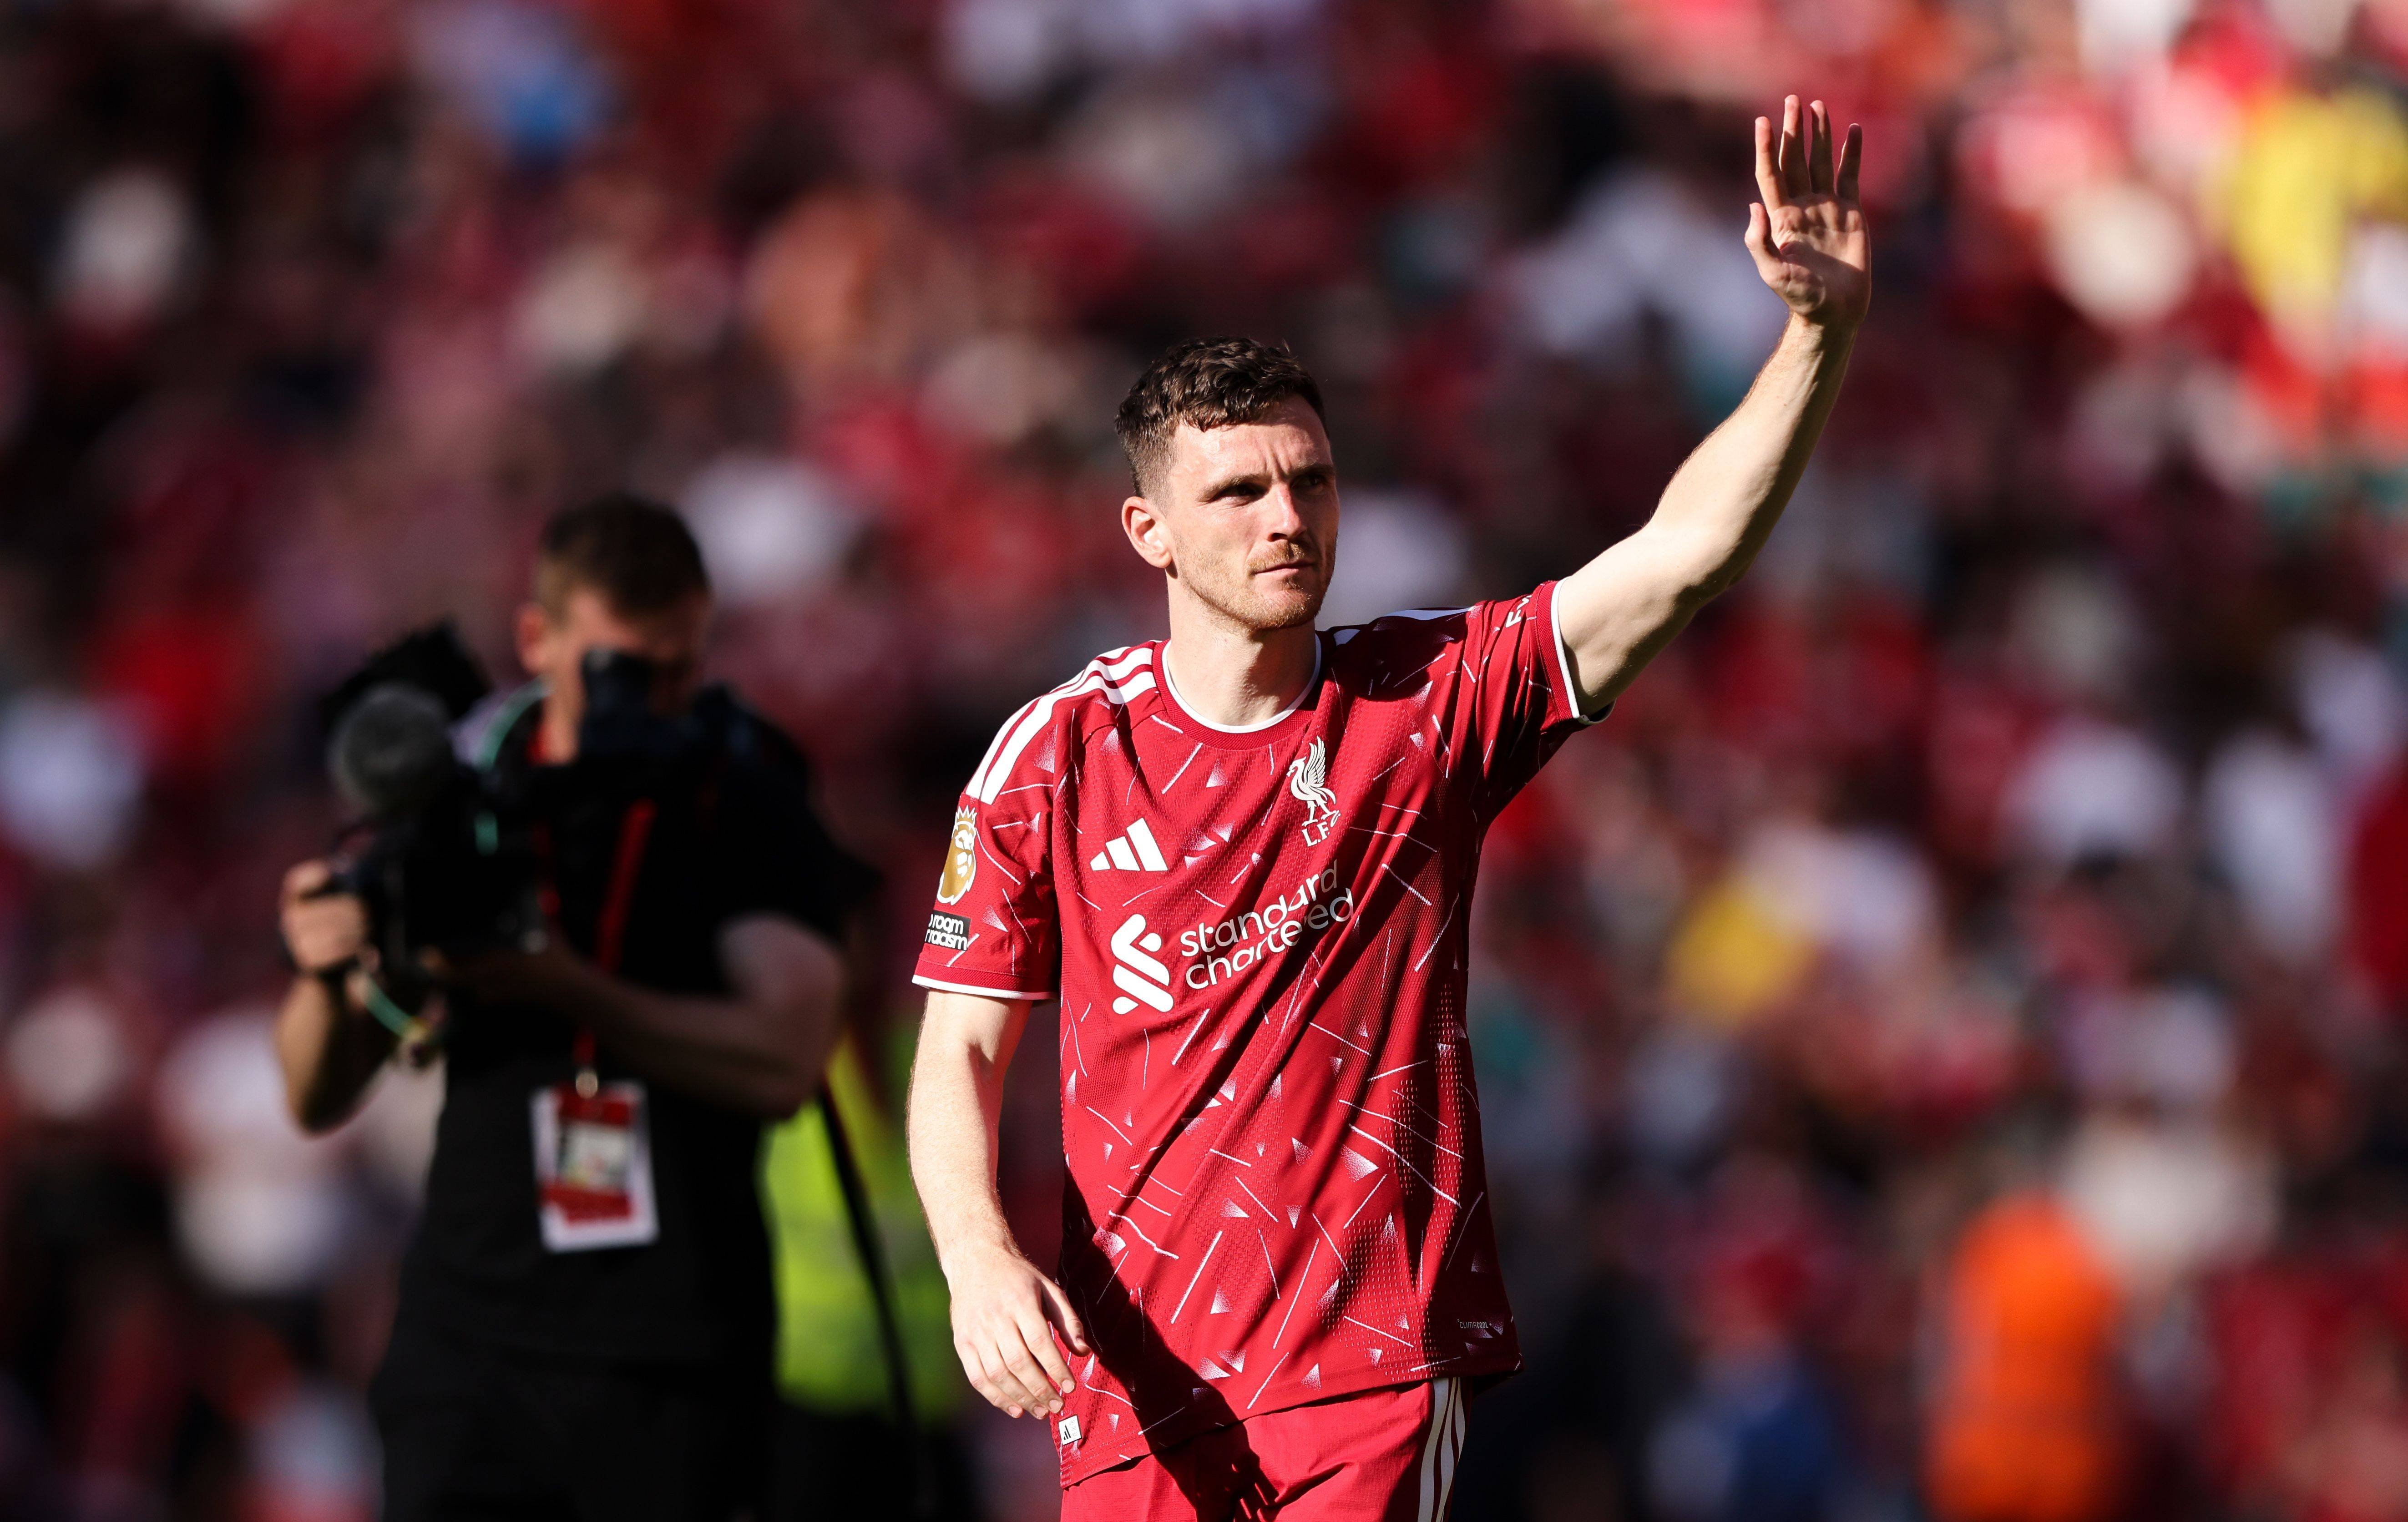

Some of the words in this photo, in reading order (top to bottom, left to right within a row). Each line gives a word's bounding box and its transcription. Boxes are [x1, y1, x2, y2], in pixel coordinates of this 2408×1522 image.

[932, 914, 964, 935] room
[1180, 859, 1337, 956] standard
[928, 930, 967, 951] racism
[1185, 887, 1354, 989] charteed
